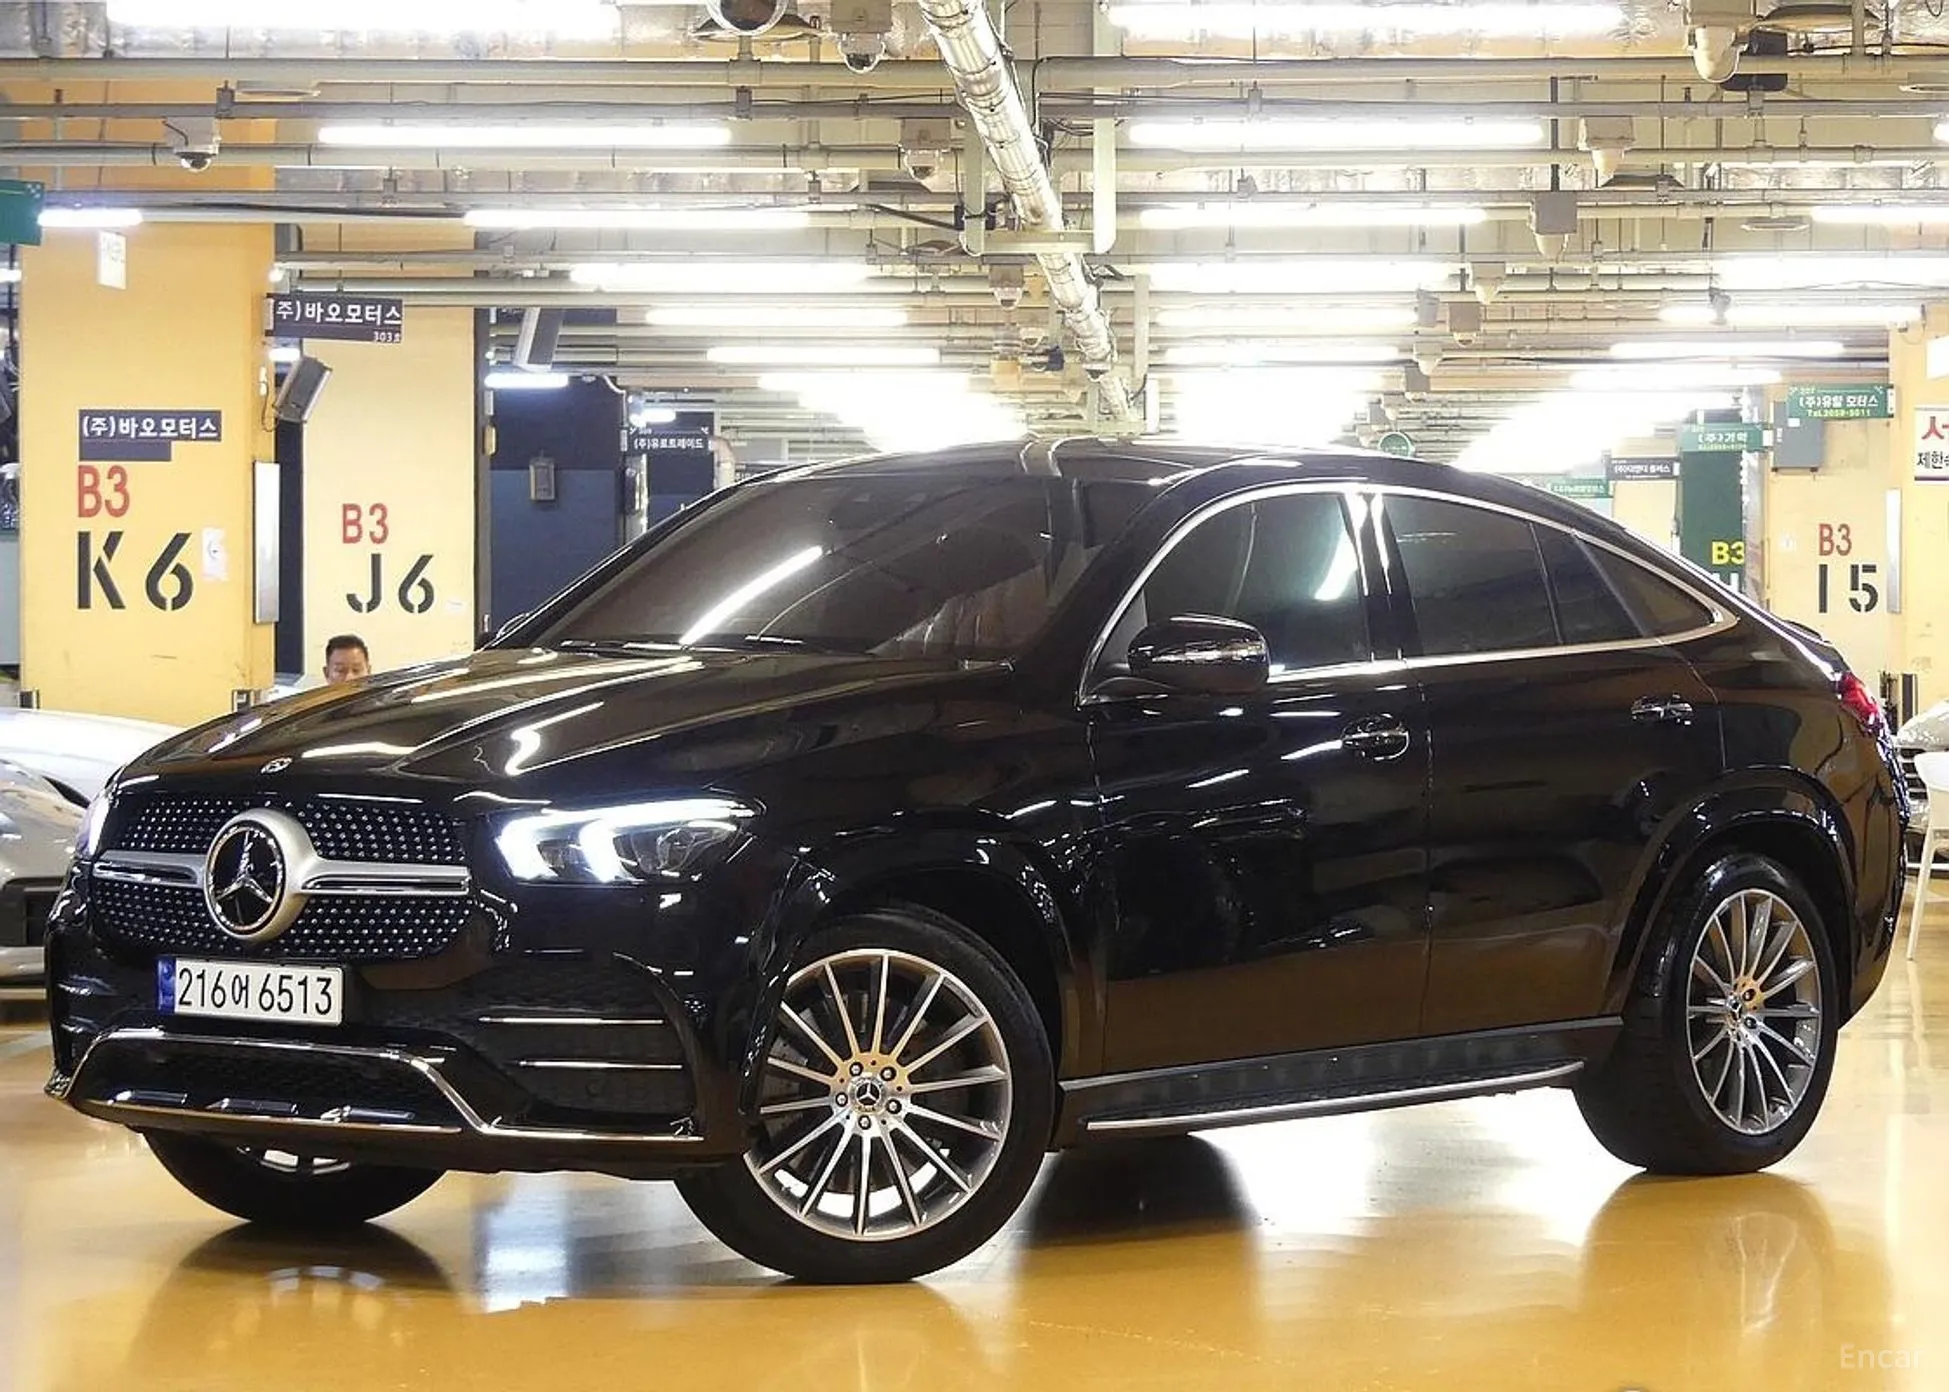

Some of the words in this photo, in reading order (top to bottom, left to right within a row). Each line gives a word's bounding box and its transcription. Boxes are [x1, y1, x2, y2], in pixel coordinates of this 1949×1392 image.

[83, 415, 219, 439] (주)바오모터스
[78, 465, 130, 518] B3
[342, 503, 389, 544] B3
[1819, 523, 1853, 556] B3
[1712, 541, 1744, 565] B3
[179, 968, 249, 1009] 216어
[259, 973, 332, 1015] 6513
